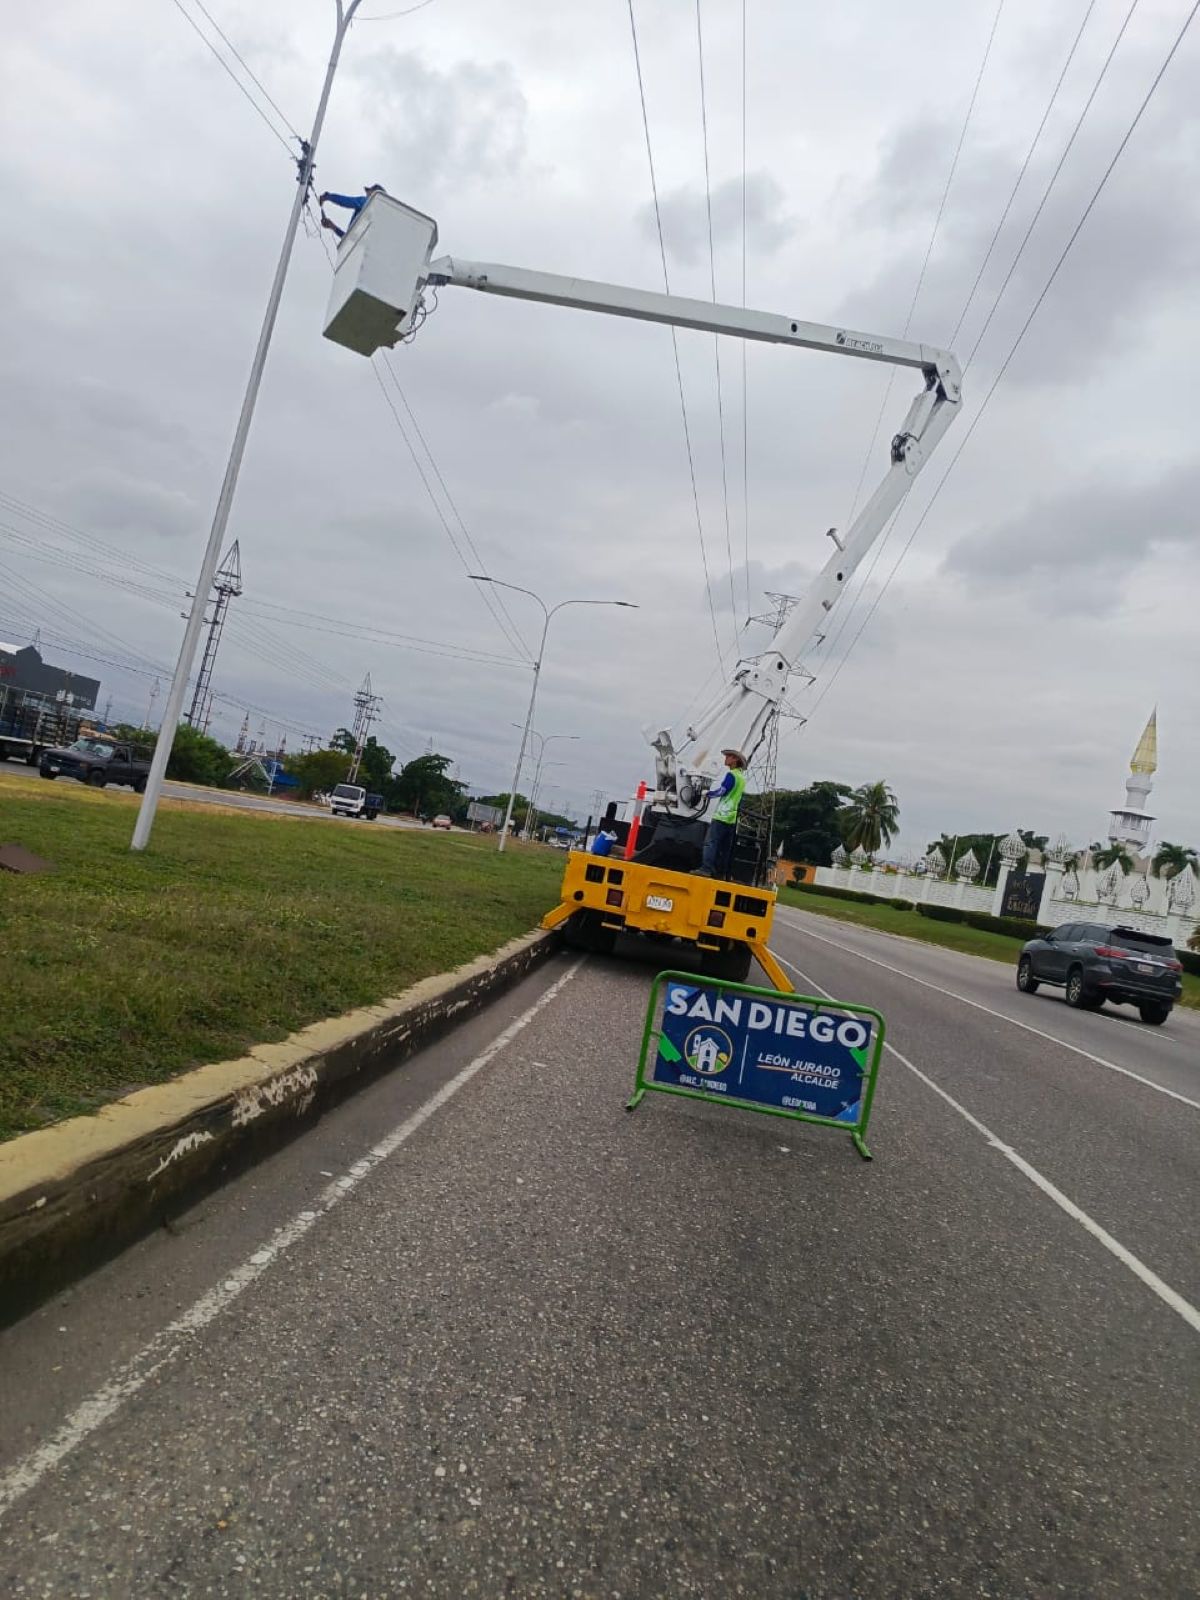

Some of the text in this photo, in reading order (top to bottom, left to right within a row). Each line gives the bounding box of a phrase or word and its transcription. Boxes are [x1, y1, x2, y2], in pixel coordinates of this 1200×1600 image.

[667, 988, 867, 1048] SAN DIEGO
[757, 1052, 841, 1078] LEÓN JURADO
[790, 1072, 840, 1090] ALCALDE
